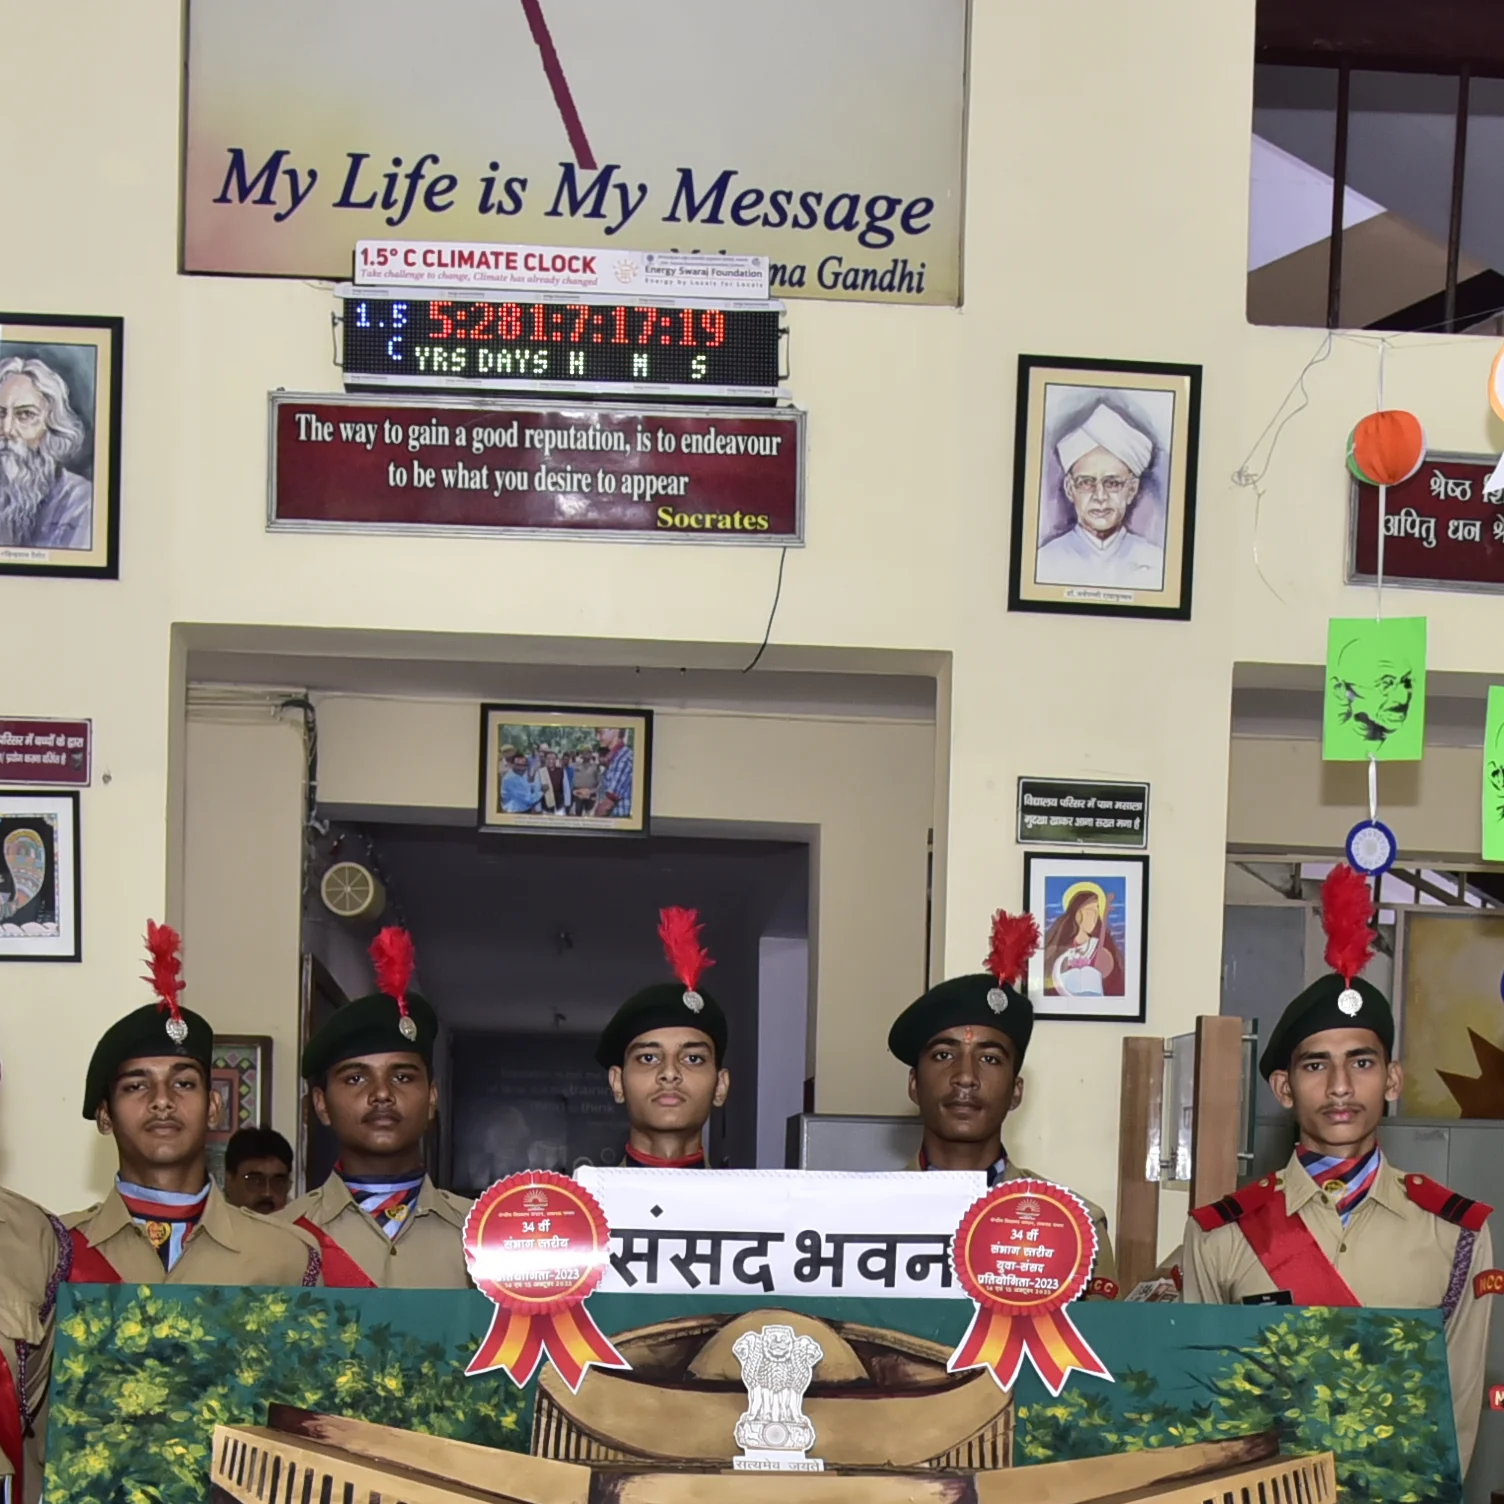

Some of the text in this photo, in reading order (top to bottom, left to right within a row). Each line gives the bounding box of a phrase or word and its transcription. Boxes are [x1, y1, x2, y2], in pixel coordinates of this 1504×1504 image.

[212, 147, 935, 250] My Life is My Message
[360, 247, 597, 275] 1.5° C CLIMATE CLOCK
[645, 265, 763, 279] Energy Swaraj Foundation
[360, 269, 599, 286] Take challenge to change, Climate has already changed
[816, 255, 927, 295] Gandhi
[356, 302, 407, 328] 1.5
[388, 335, 403, 361] C
[415, 345, 707, 379] YRS DAYS H M S
[294, 412, 782, 457] The way to gain a good reputation, is to endeavour
[388, 459, 690, 502] to be what you desire to appear
[1429, 469, 1473, 501] श्रेष्ठ
[657, 505, 769, 531] Socrates
[1383, 507, 1437, 549] अपितु
[1447, 519, 1482, 542] धन
[1023, 793, 1143, 811] विद्यालय परिसर में पान मसाला
[521, 1221, 535, 1233] 34
[1009, 1228, 1024, 1241] 34
[609, 1204, 955, 1293] संसद भवन
[990, 1240, 1055, 1258] संभाग स्तरीय
[1094, 1279, 1114, 1293] CC
[1478, 1274, 1504, 1292] NCC
[735, 1457, 781, 1470] सत्यमेव
